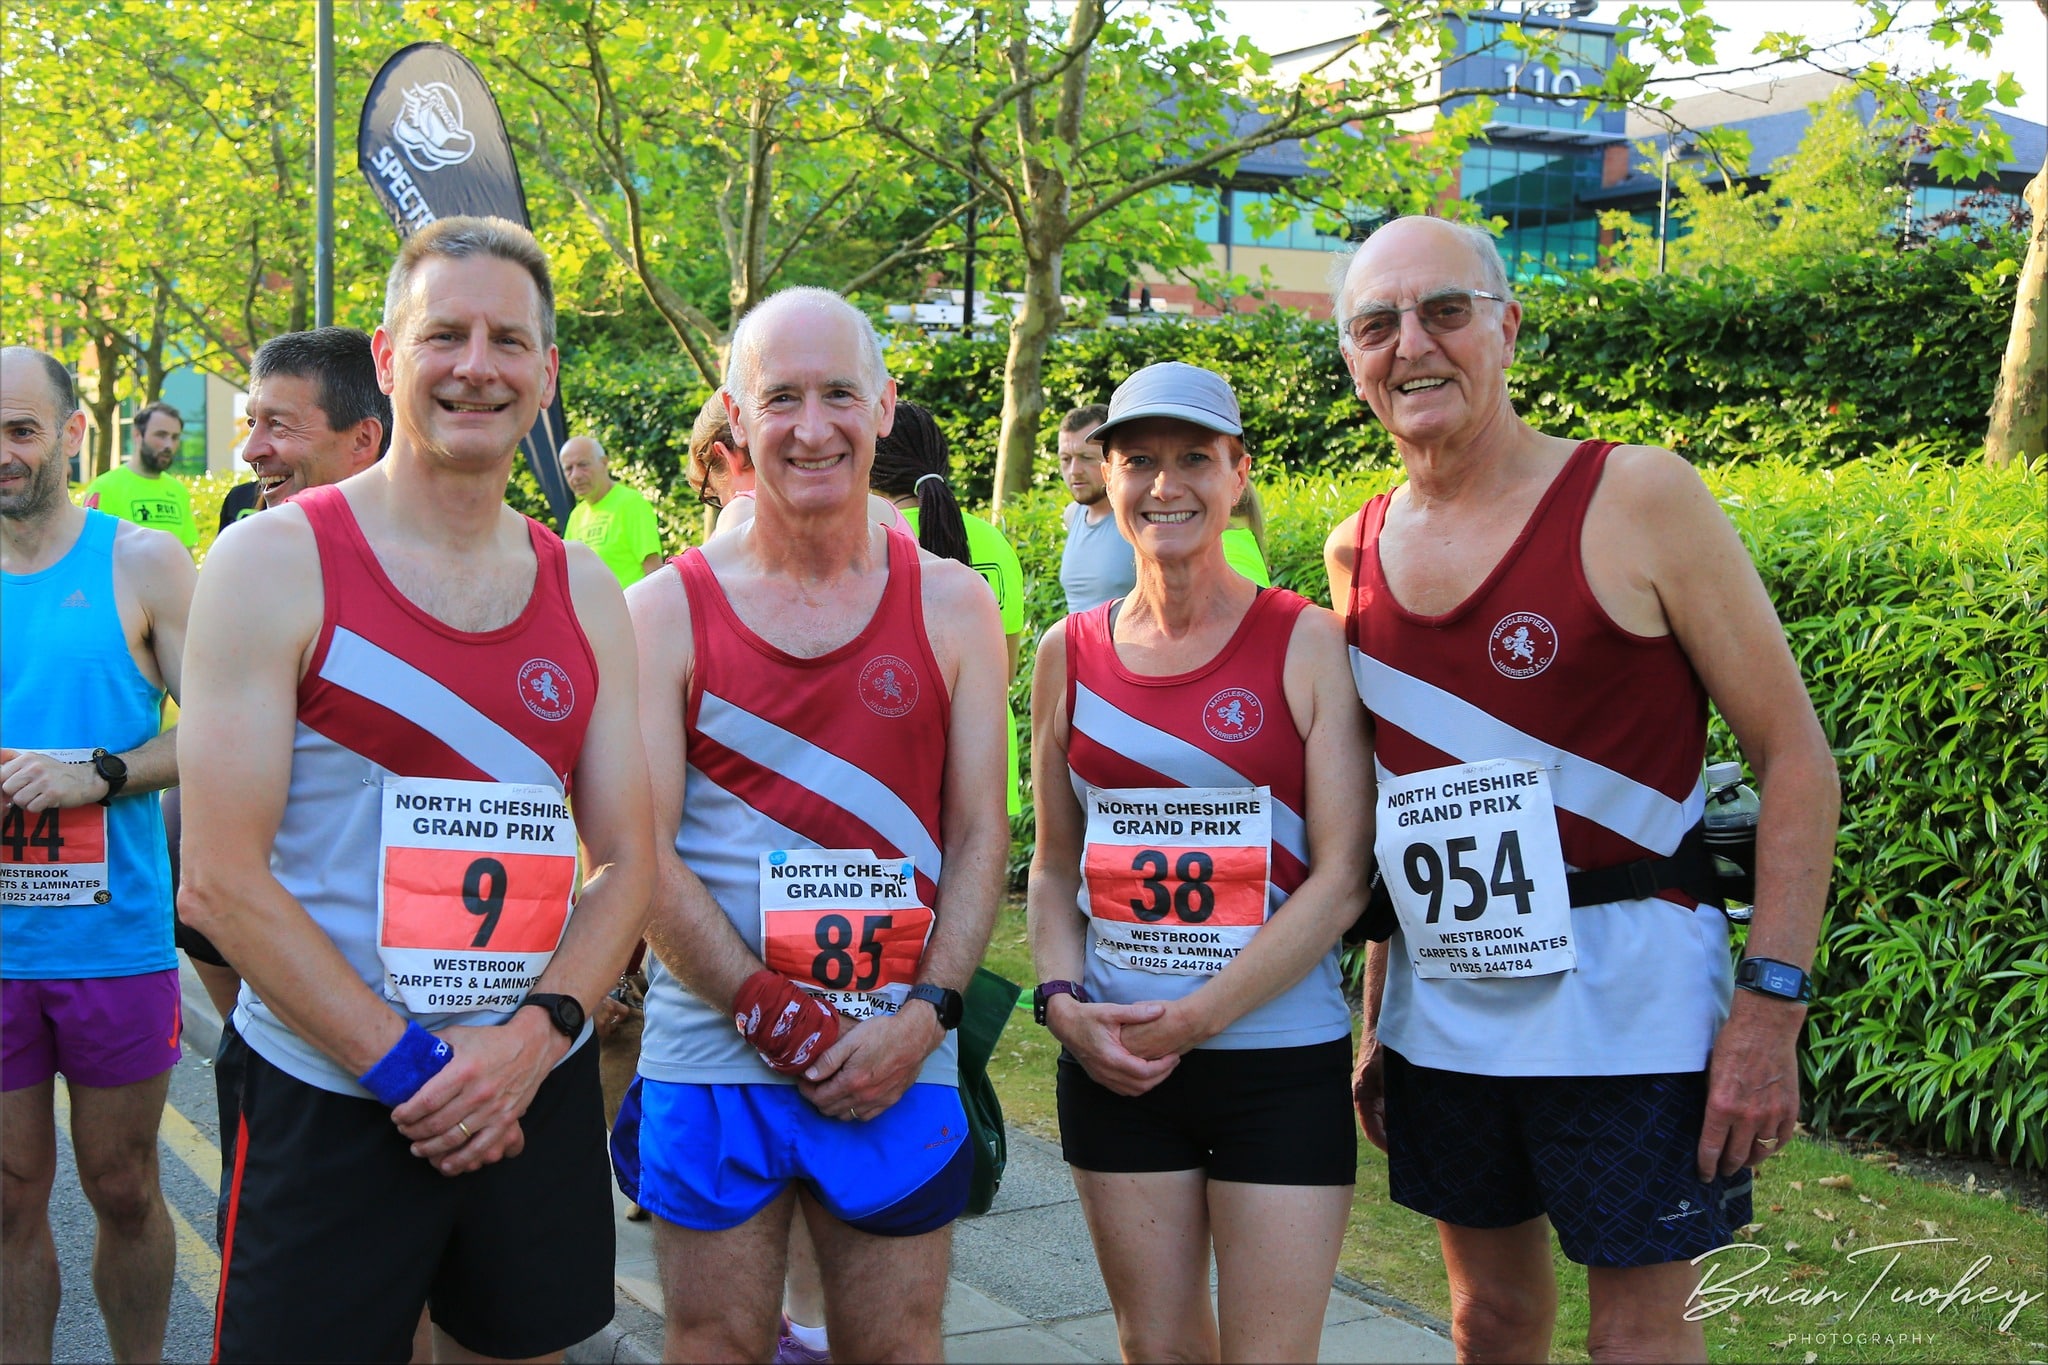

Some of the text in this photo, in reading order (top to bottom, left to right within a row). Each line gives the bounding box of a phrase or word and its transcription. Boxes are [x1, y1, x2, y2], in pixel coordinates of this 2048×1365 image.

[1504, 63, 1581, 107] 110
[1494, 615, 1550, 639] MACCLESFIELD
[1497, 660, 1535, 676] HARRIERS
[1209, 690, 1258, 708] MACCLESFIELD
[1387, 771, 1539, 809] NORTH CHESHIRE
[395, 794, 569, 820] NORTH CHESHIRE
[1098, 801, 1261, 816] NORTH CHESHIRE
[1397, 794, 1522, 828] GRAND PRIX
[413, 817, 556, 842] GRAND PRIX
[1112, 820, 1242, 836] GRAND PRIX
[771, 865, 837, 878] NORTH
[1403, 830, 1536, 924] 954
[21, 881, 29, 889] &
[33, 880, 101, 889] LAMINATES
[786, 884, 863, 898] GRAND
[1130, 850, 1215, 923] 38
[0, 893, 70, 901] 1925 244784
[462, 857, 508, 948] 9
[1131, 930, 1221, 943] WESTBROOK
[1439, 926, 1525, 945] WESTBROOK
[811, 914, 893, 991] 85
[1163, 946, 1173, 954] &
[1178, 947, 1243, 959] LAMINAT
[1419, 935, 1568, 958] CARPETS & LAMINATES
[433, 959, 526, 972] WESTBROOK
[1130, 956, 1223, 972] 01925 244784
[1450, 958, 1533, 973] 01925 244784
[468, 979, 479, 989] &
[428, 994, 520, 1006] 01925 244784
[843, 992, 853, 1003] &
